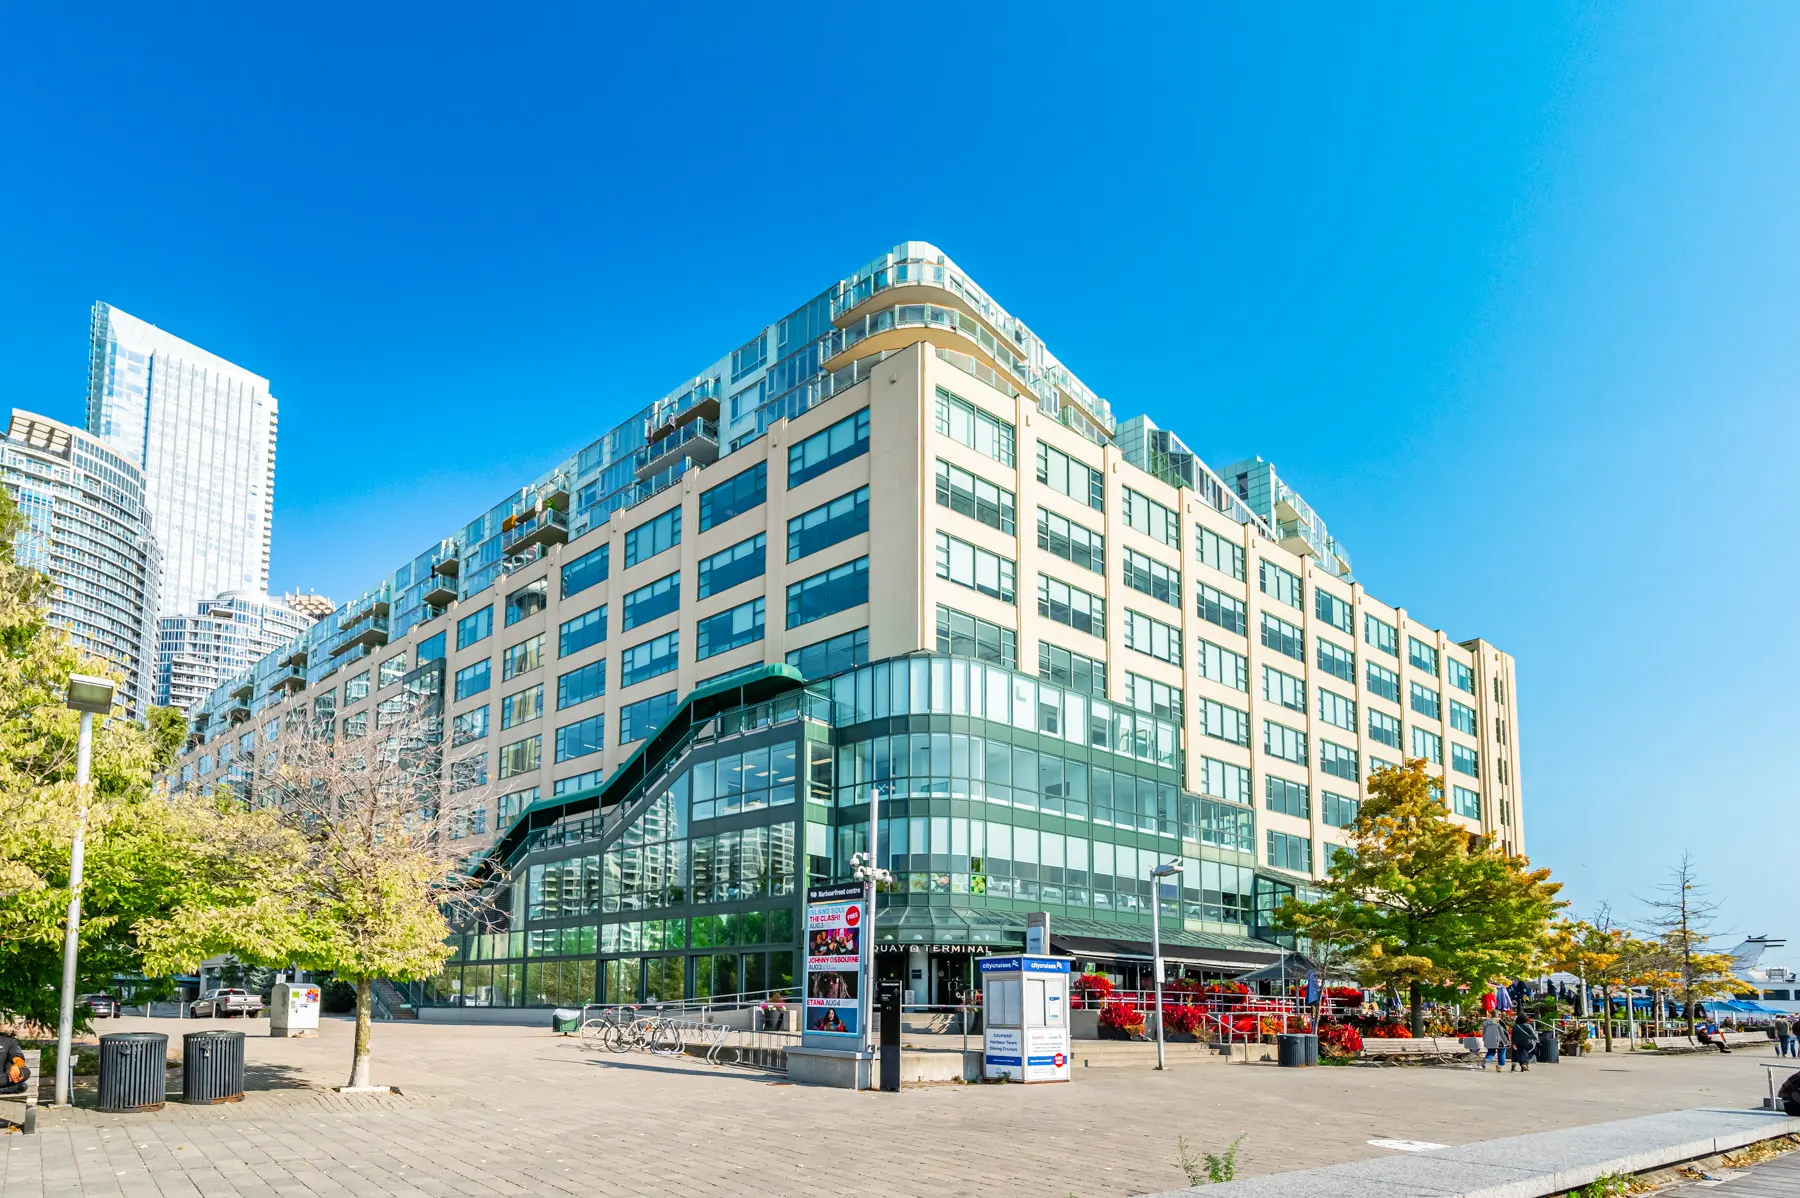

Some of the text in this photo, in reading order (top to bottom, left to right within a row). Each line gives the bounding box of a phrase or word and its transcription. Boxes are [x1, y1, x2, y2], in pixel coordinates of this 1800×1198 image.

[818, 889, 845, 897] Harbourfront
[847, 912, 858, 920] FREE
[923, 944, 991, 953] TERMINAL
